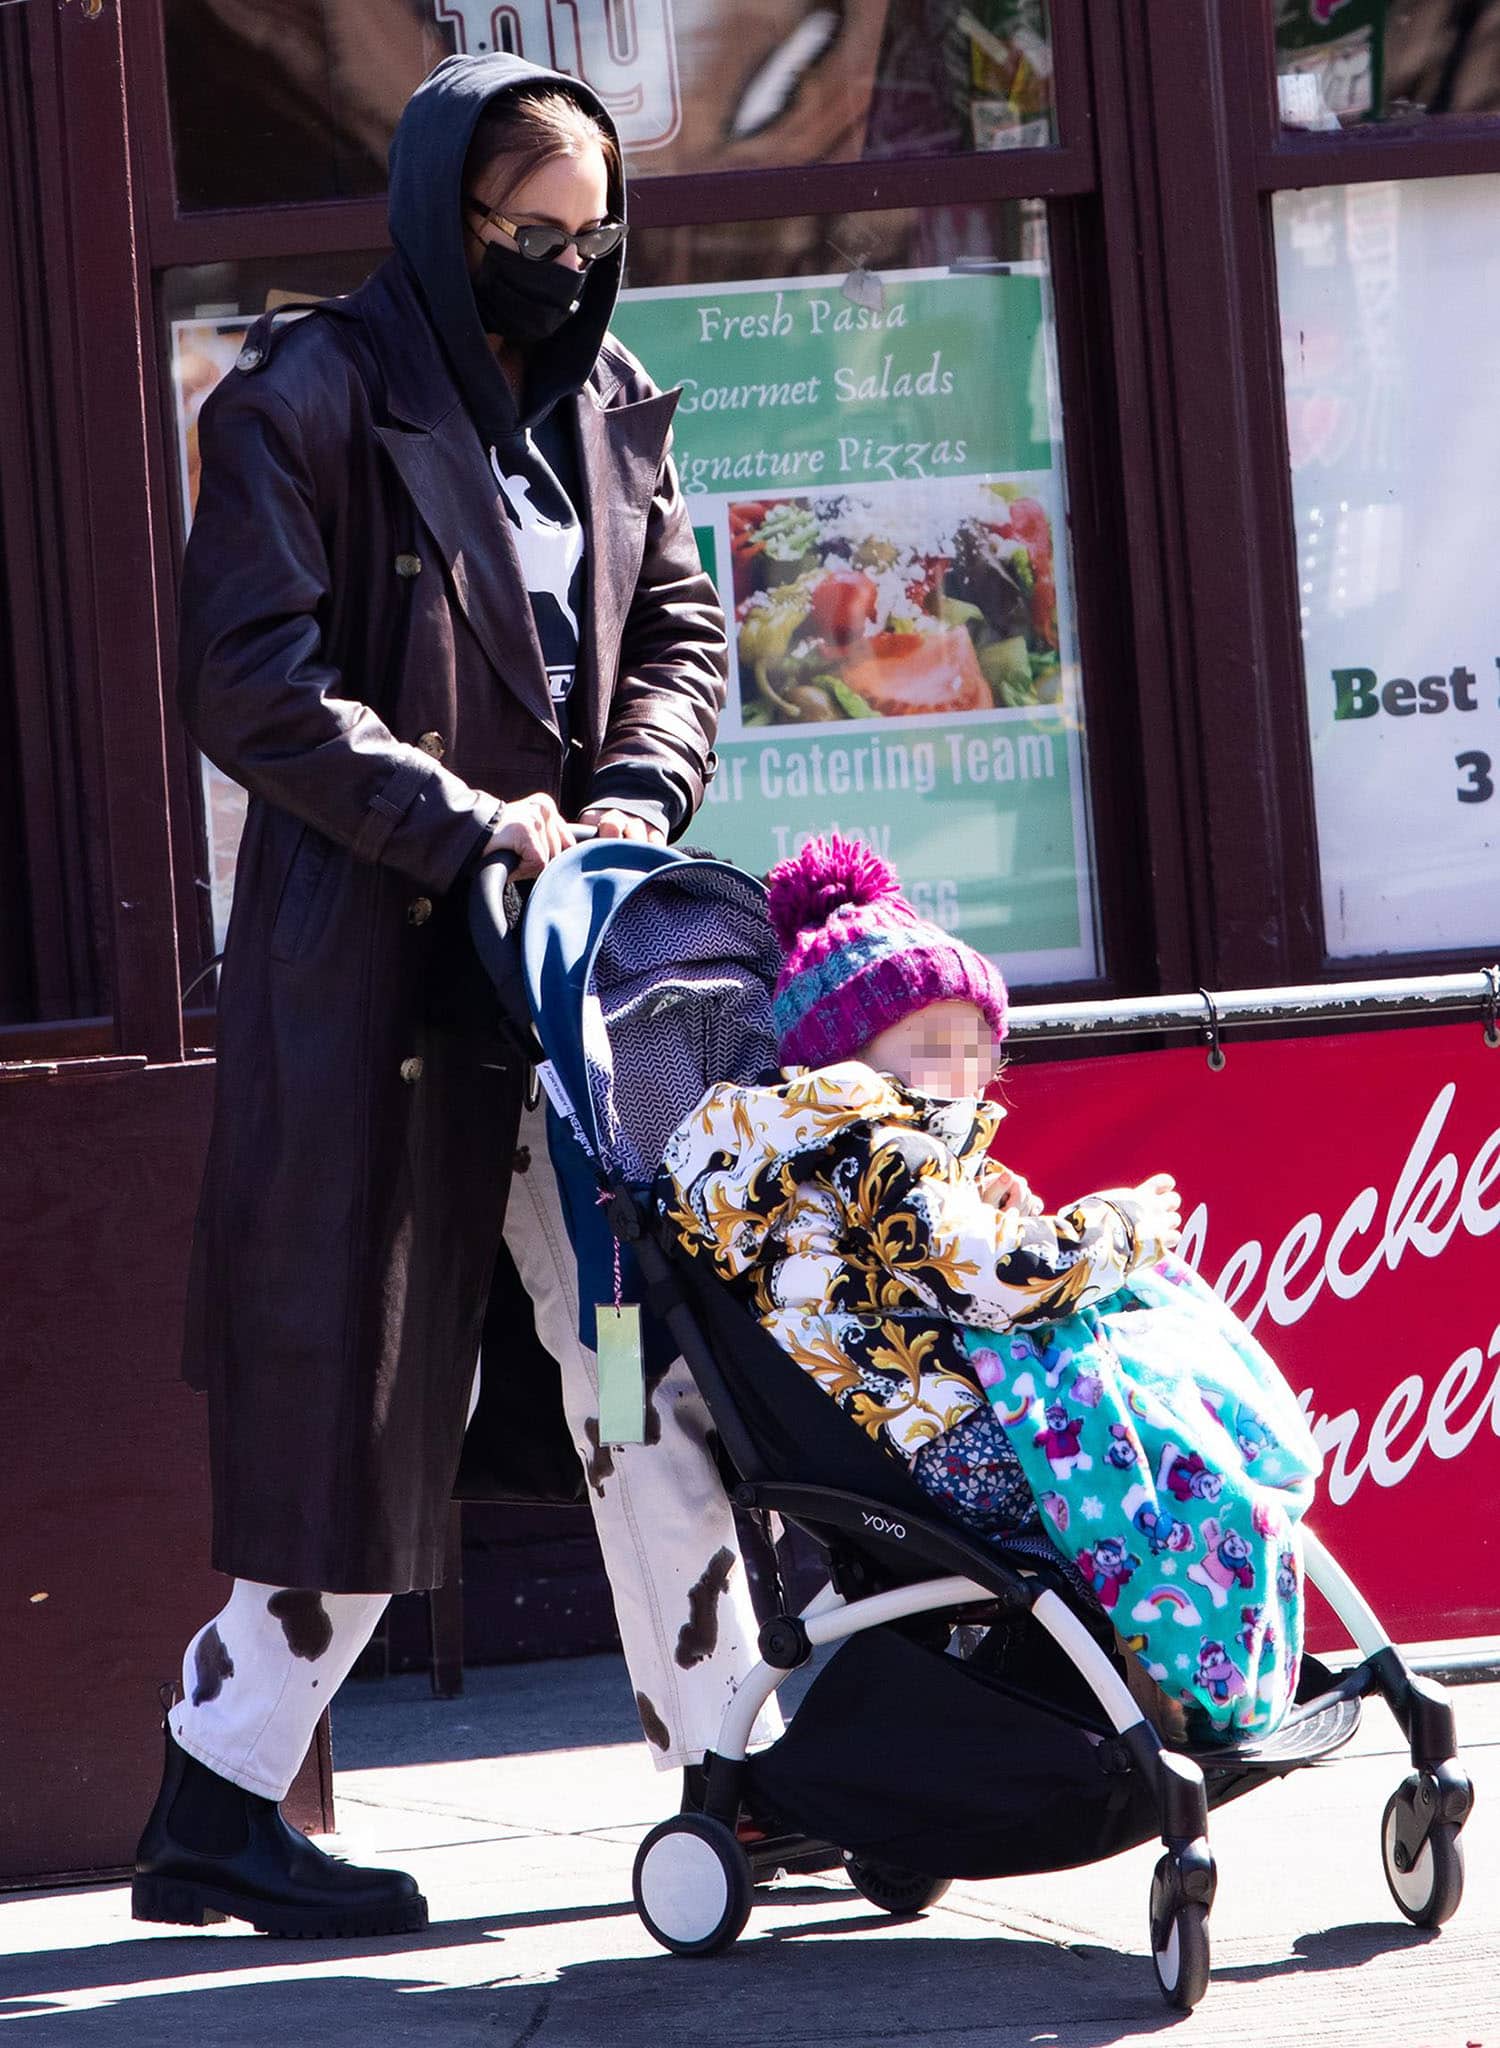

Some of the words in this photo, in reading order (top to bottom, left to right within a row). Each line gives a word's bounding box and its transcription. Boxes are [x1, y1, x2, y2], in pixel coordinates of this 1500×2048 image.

[697, 293, 794, 342] Fresh
[808, 299, 907, 336] Pasta
[676, 376, 821, 413] Gourmet
[834, 351, 954, 400] Salads
[679, 450, 825, 495] ignature
[838, 437, 967, 480] Pizzas
[1331, 666, 1478, 720] Best
[707, 757, 747, 803] ur
[759, 736, 934, 799] Catering
[945, 732, 1055, 784] Team
[861, 1511, 906, 1539] YOYO
